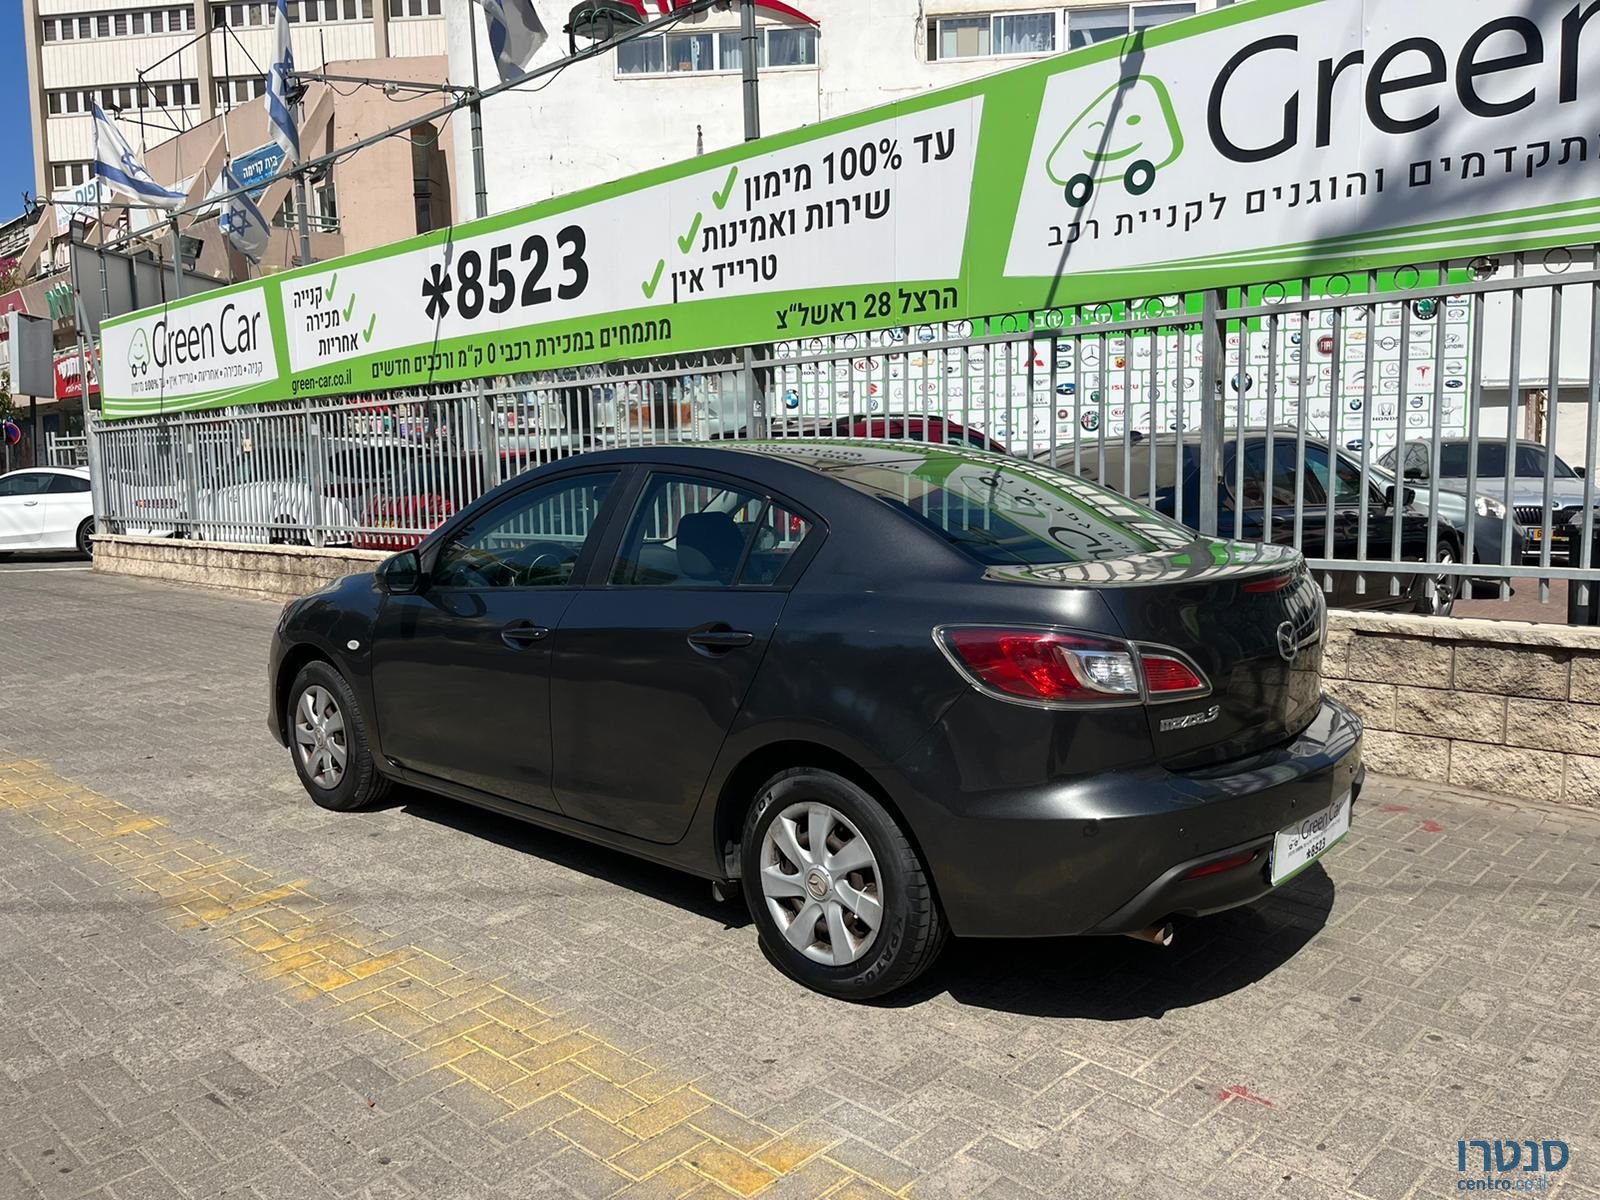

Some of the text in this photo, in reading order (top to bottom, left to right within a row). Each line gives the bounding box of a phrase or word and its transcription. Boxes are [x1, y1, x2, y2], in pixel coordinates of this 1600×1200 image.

[744, 127, 956, 211] עד 100% מימון
[1048, 134, 1600, 248] תקדמים והוגנים לקניית רכב
[702, 188, 891, 253] שירות ואמינות
[671, 254, 778, 304] טרייד אין
[293, 286, 323, 309] קנייה
[864, 291, 891, 319] 28
[898, 286, 958, 315] הרצל
[306, 309, 340, 332] מכירה
[600, 317, 672, 347] מתמחים
[152, 303, 261, 368] Green Car
[318, 332, 359, 356] אחריות
[536, 331, 595, 358] במכירת
[415, 350, 454, 373] ורכבים
[487, 342, 496, 364] 0
[499, 340, 531, 362] רכבי
[372, 357, 410, 378] חדשים
[292, 368, 352, 395] green-car.co.il
[1302, 813, 1328, 840] Green
